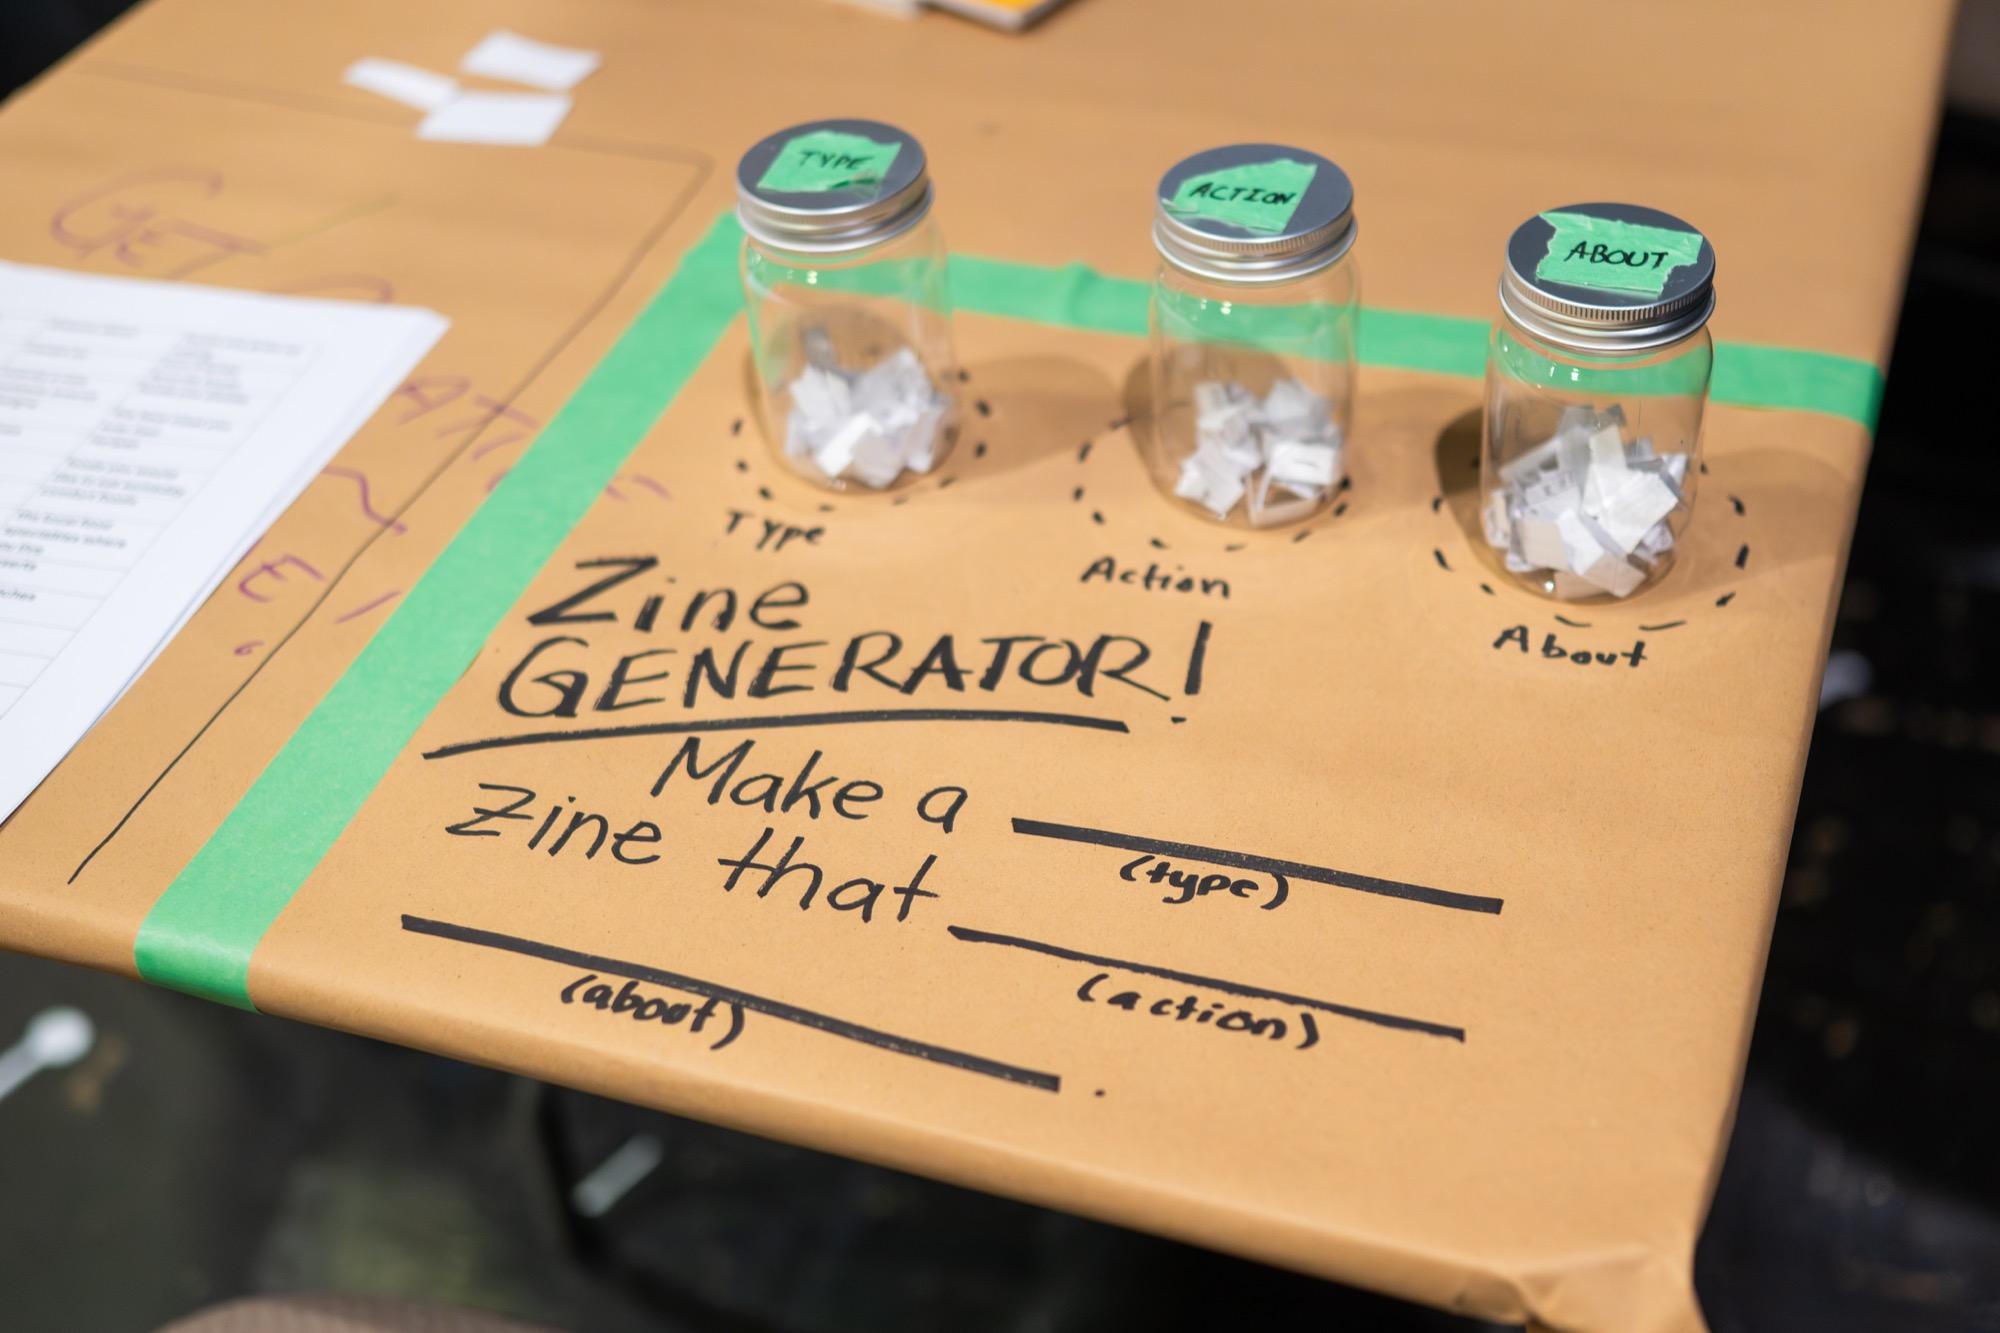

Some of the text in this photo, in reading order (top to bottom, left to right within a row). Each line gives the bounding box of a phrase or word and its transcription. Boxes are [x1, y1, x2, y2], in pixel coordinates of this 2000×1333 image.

[800, 149, 876, 171] TYPE
[1187, 179, 1296, 206] ACTION
[1563, 240, 1670, 270] ABOUT
[726, 510, 825, 551] Type
[526, 555, 810, 634] Zine
[1079, 556, 1231, 599] Action
[497, 620, 1213, 724] GENERATOR!
[1492, 625, 1648, 669] About
[649, 736, 970, 835] Make a
[716, 826, 940, 924] that
[1118, 853, 1291, 912] (type)
[559, 972, 746, 1051] (about)
[1075, 972, 1321, 1051] (action)
